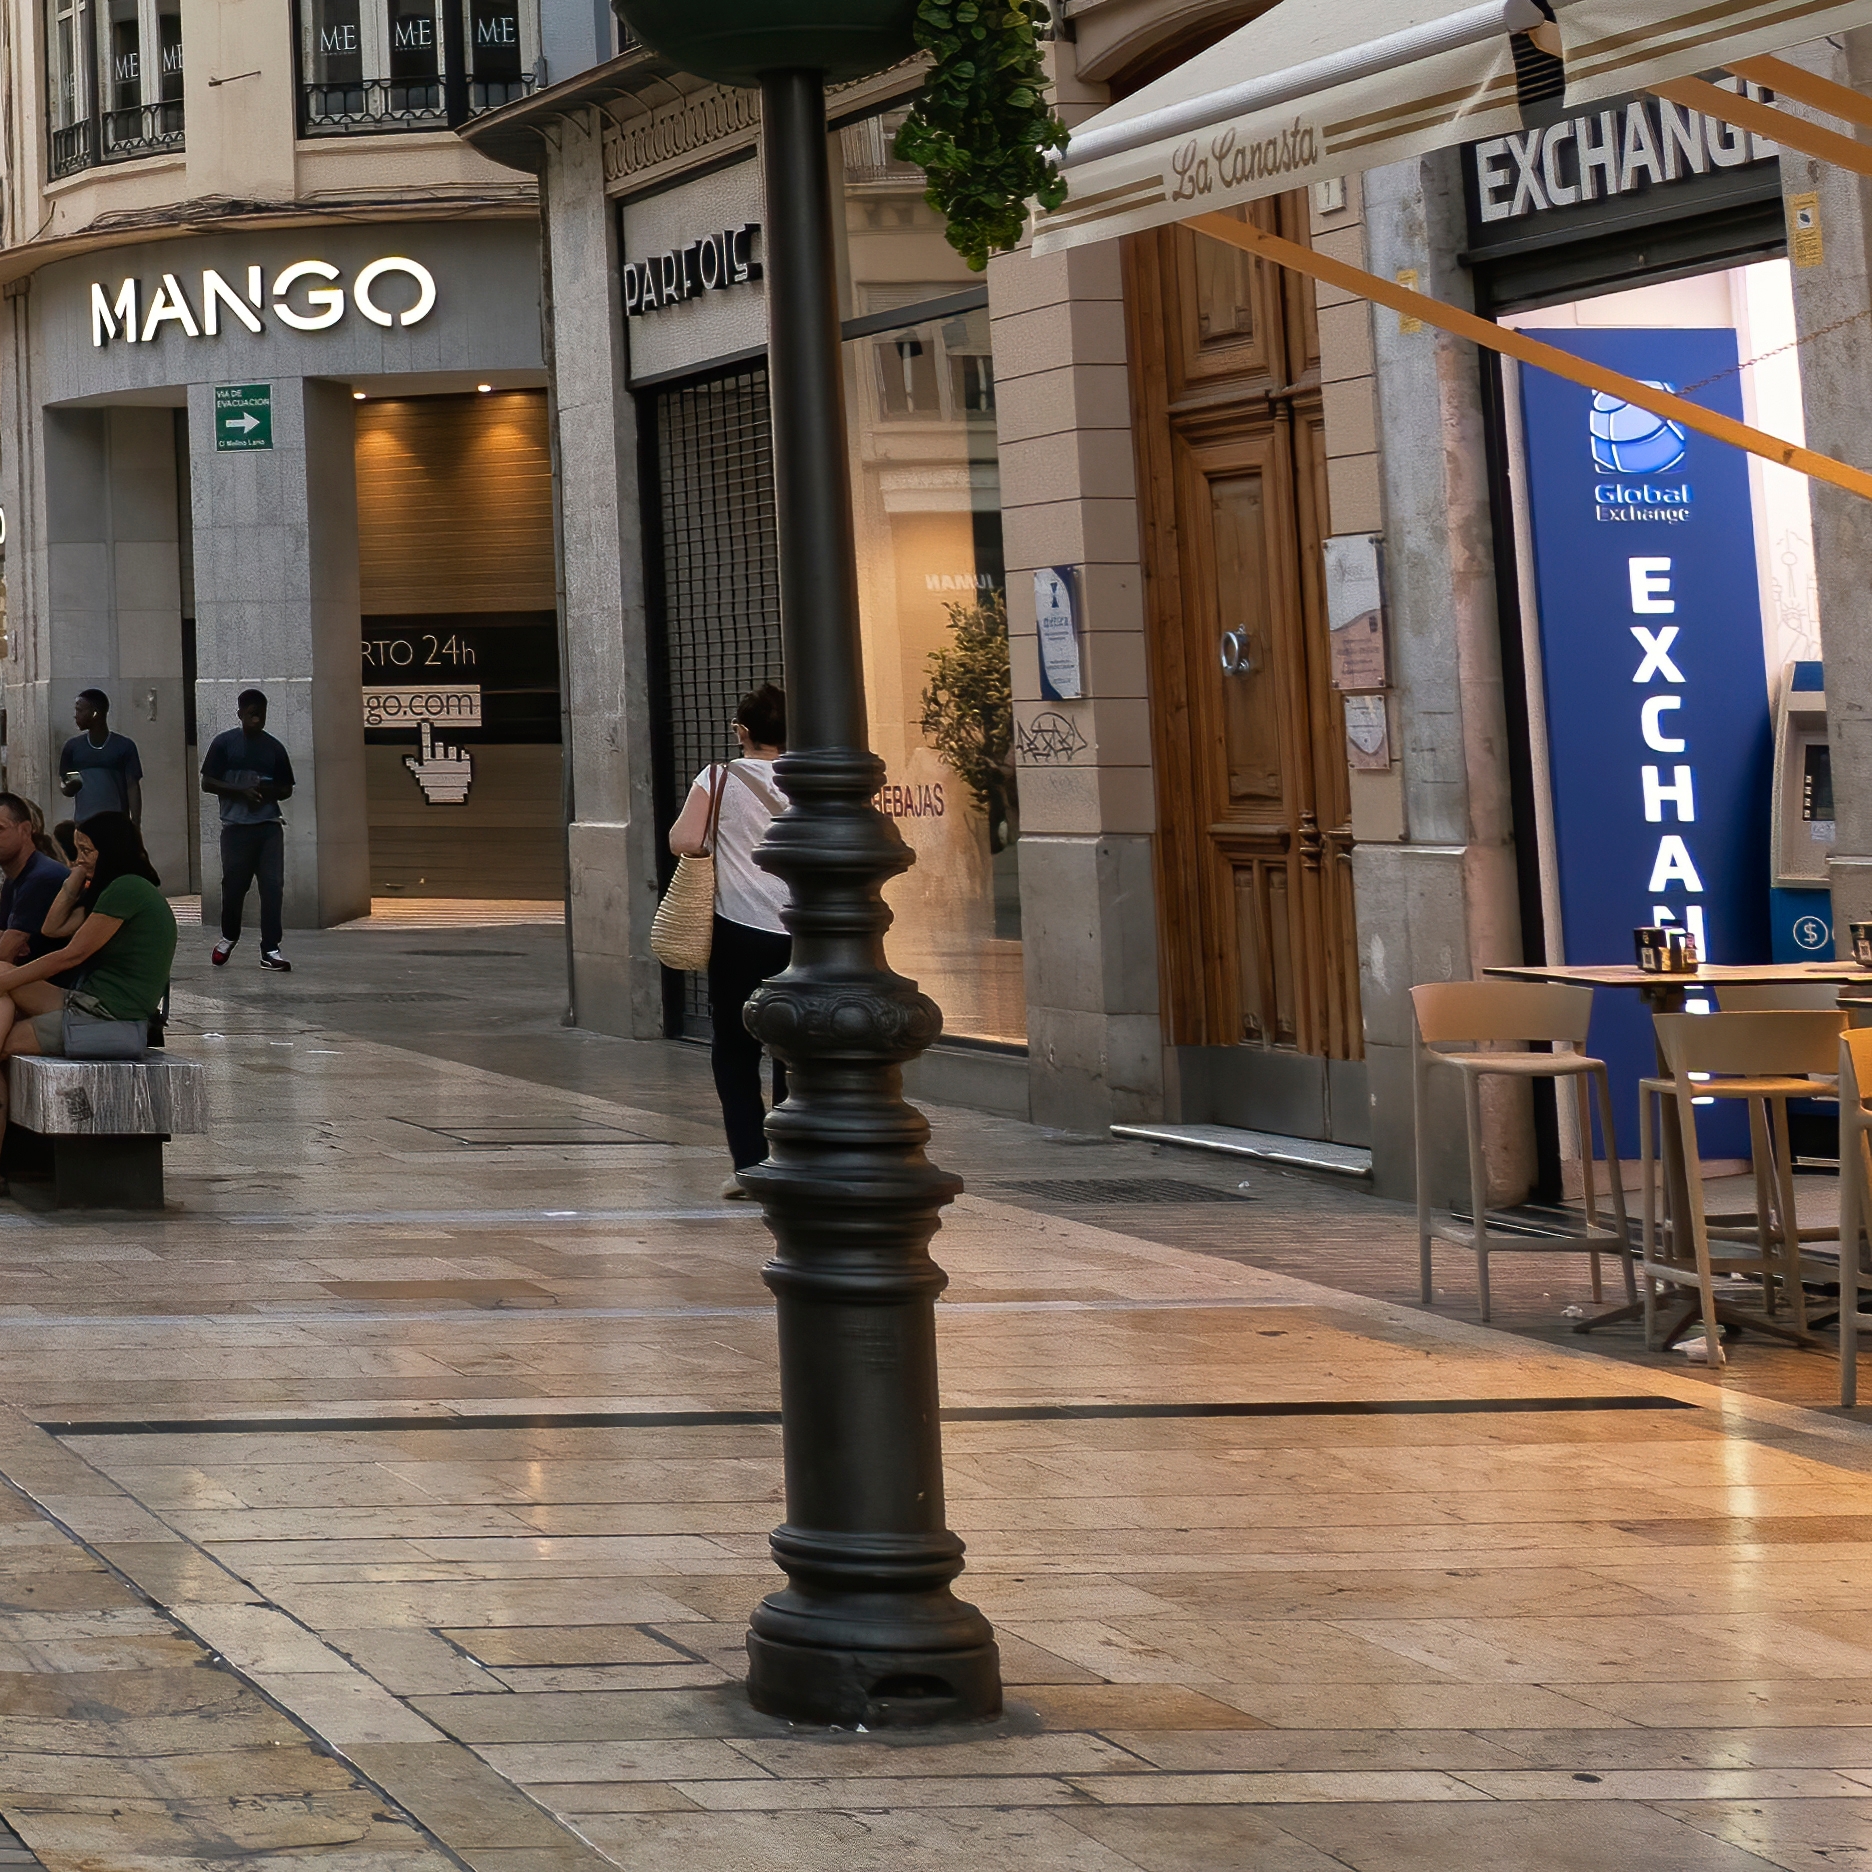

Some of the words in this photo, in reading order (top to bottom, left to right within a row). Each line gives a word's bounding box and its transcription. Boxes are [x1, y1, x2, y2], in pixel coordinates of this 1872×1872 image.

[1171, 138, 1214, 203] La
[1211, 116, 1319, 189] Canasta
[624, 222, 763, 316] PARFOIS
[91, 256, 437, 347] MANGO
[1594, 484, 1693, 504] Global
[1596, 504, 1691, 524] Exchange
[422, 634, 475, 665] 24h
[366, 693, 474, 726] go.com
